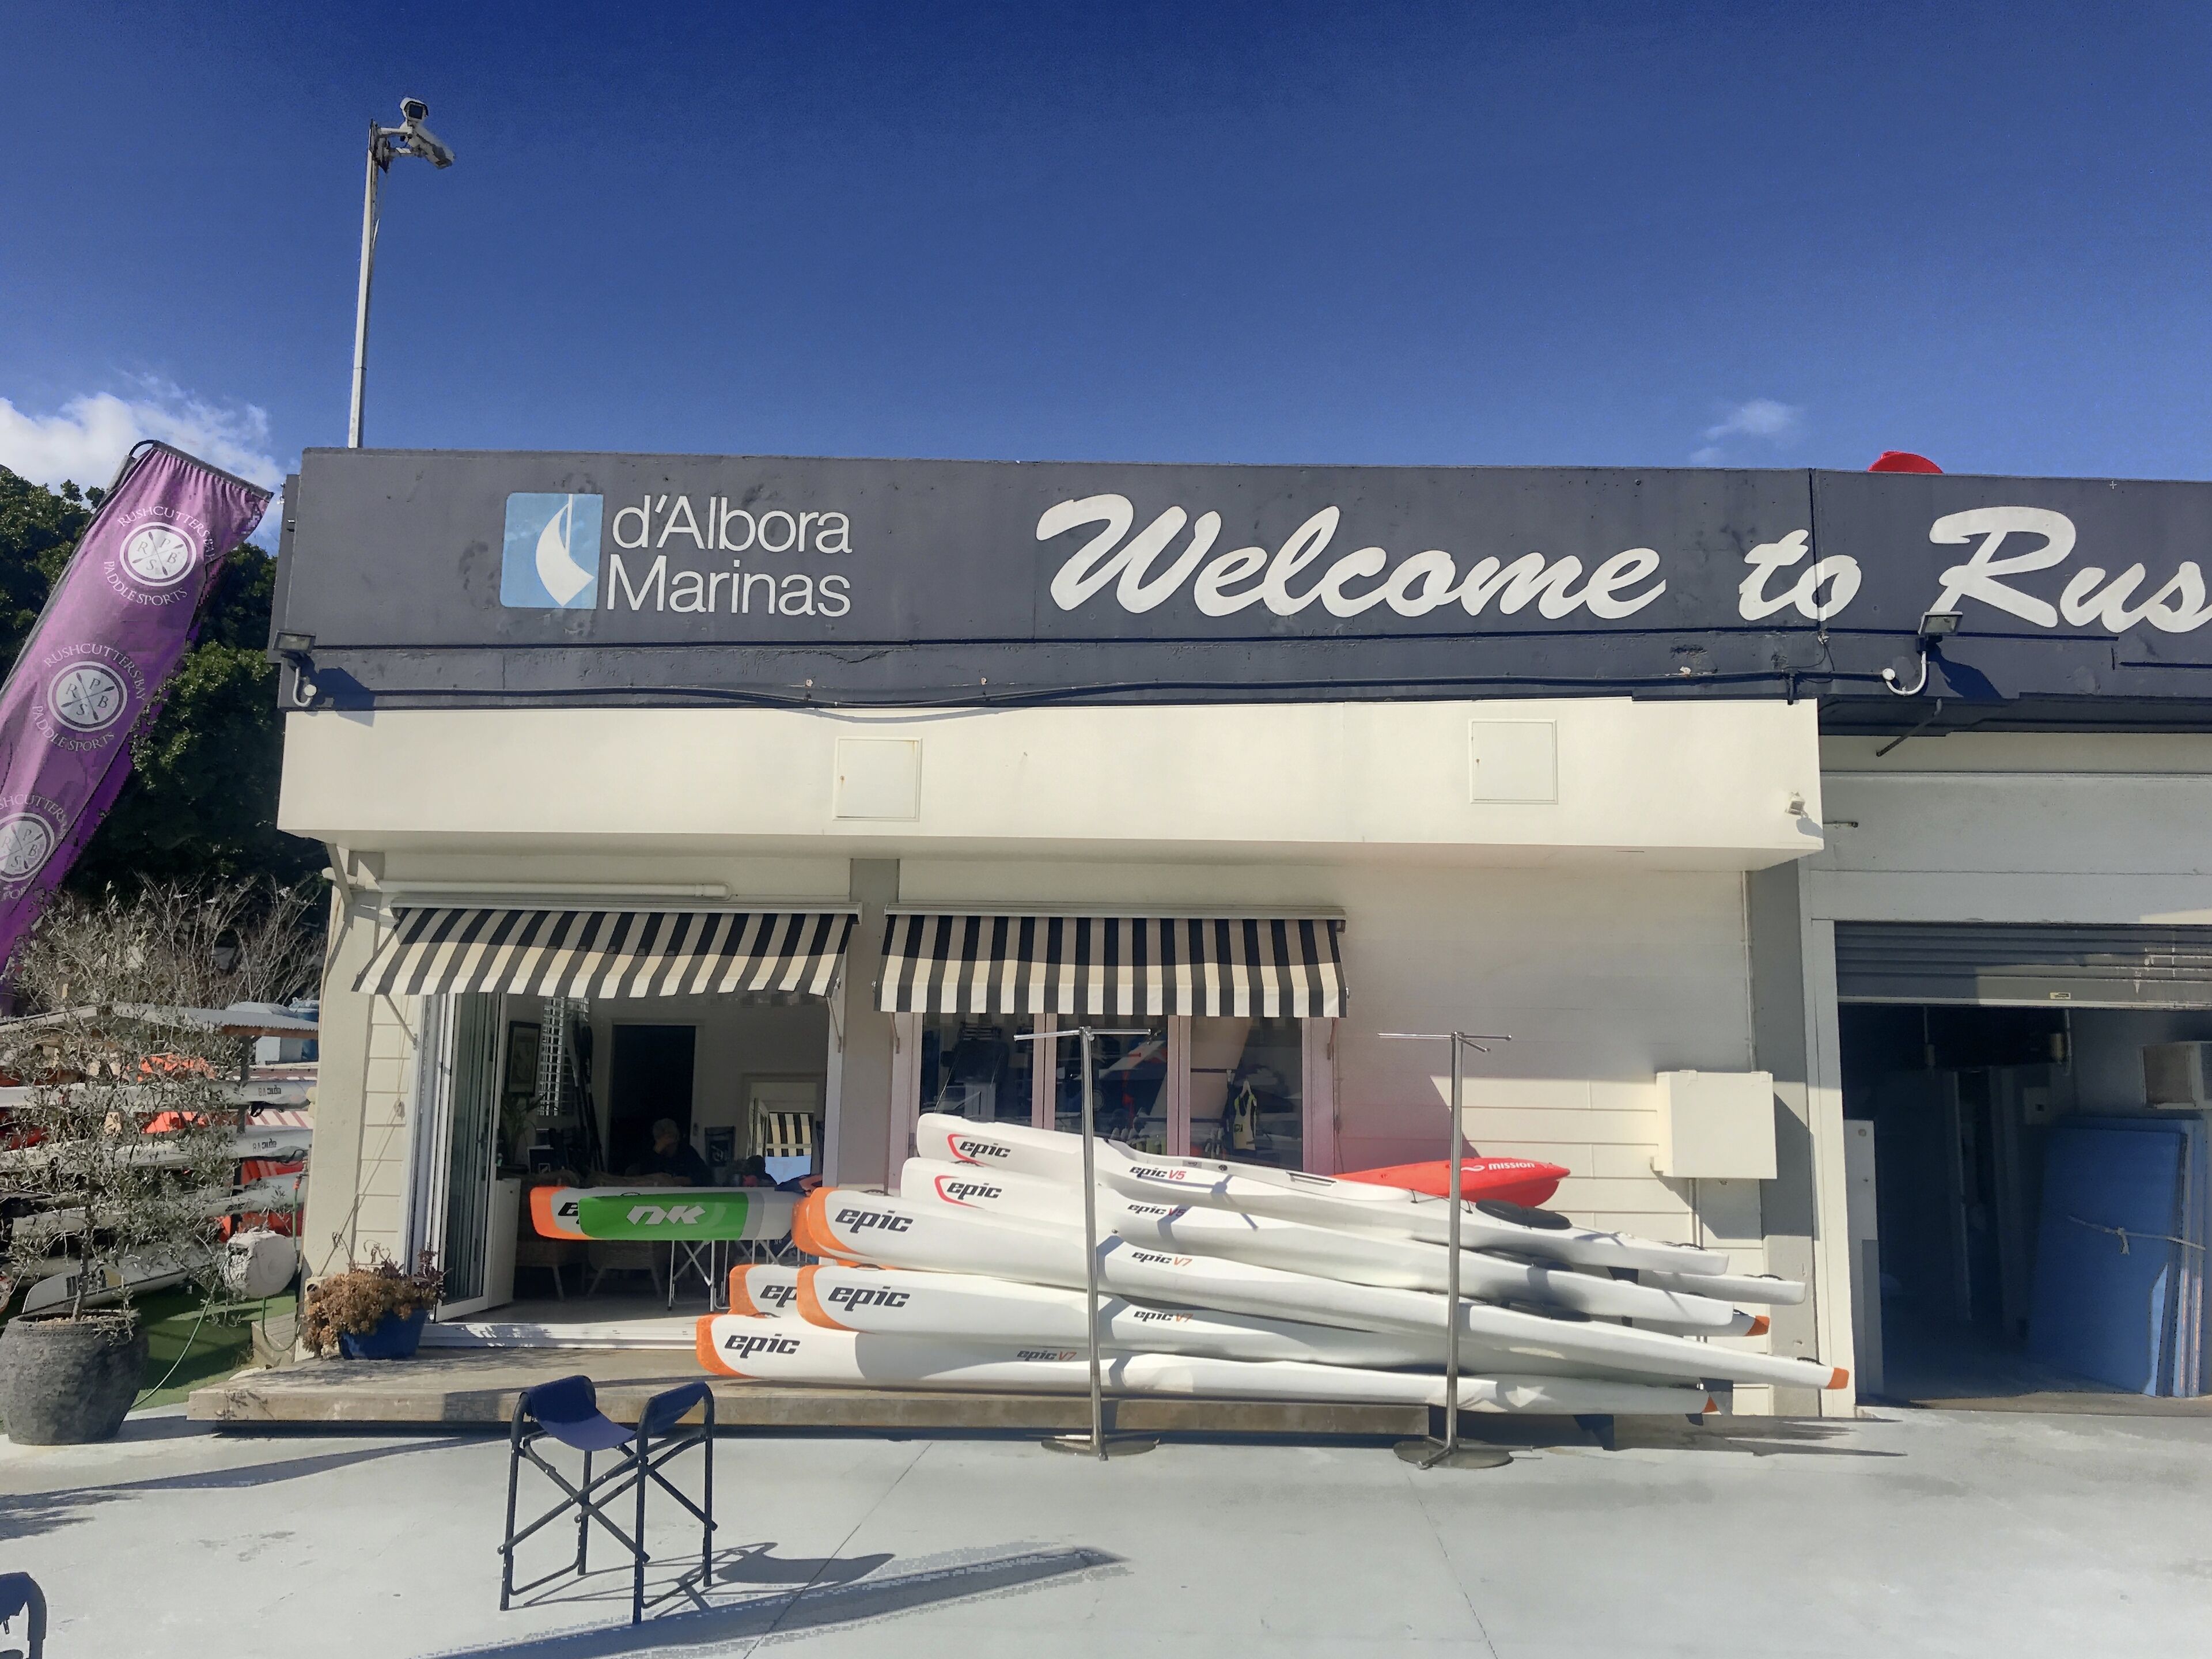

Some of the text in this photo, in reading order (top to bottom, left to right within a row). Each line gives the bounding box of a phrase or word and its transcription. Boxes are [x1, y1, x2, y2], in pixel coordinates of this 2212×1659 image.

[118, 506, 210, 537] RUSHCUTTERS
[612, 494, 852, 554] d'Albora
[1036, 493, 2212, 633] Welcome to Rus
[104, 560, 188, 605] PADDLE SPORTS
[607, 554, 851, 617] Marinas
[44, 643, 146, 700] RUSHCUTTERS BAY
[32, 705, 115, 752] PADDLE SPORTS
[959, 1141, 1011, 1158] epic
[1129, 1166, 1187, 1180] epic V5
[1488, 1162, 1535, 1171] mission
[946, 1182, 1002, 1200] epic
[835, 1209, 914, 1233] epic
[1127, 1204, 1186, 1217] epic V5
[1131, 1252, 1193, 1267] epic V7
[760, 1285, 797, 1308] ep
[828, 1286, 911, 1312] epic
[1134, 1310, 1194, 1323] epic V7
[725, 1334, 801, 1359] epic
[1017, 1350, 1077, 1361] epic V7
